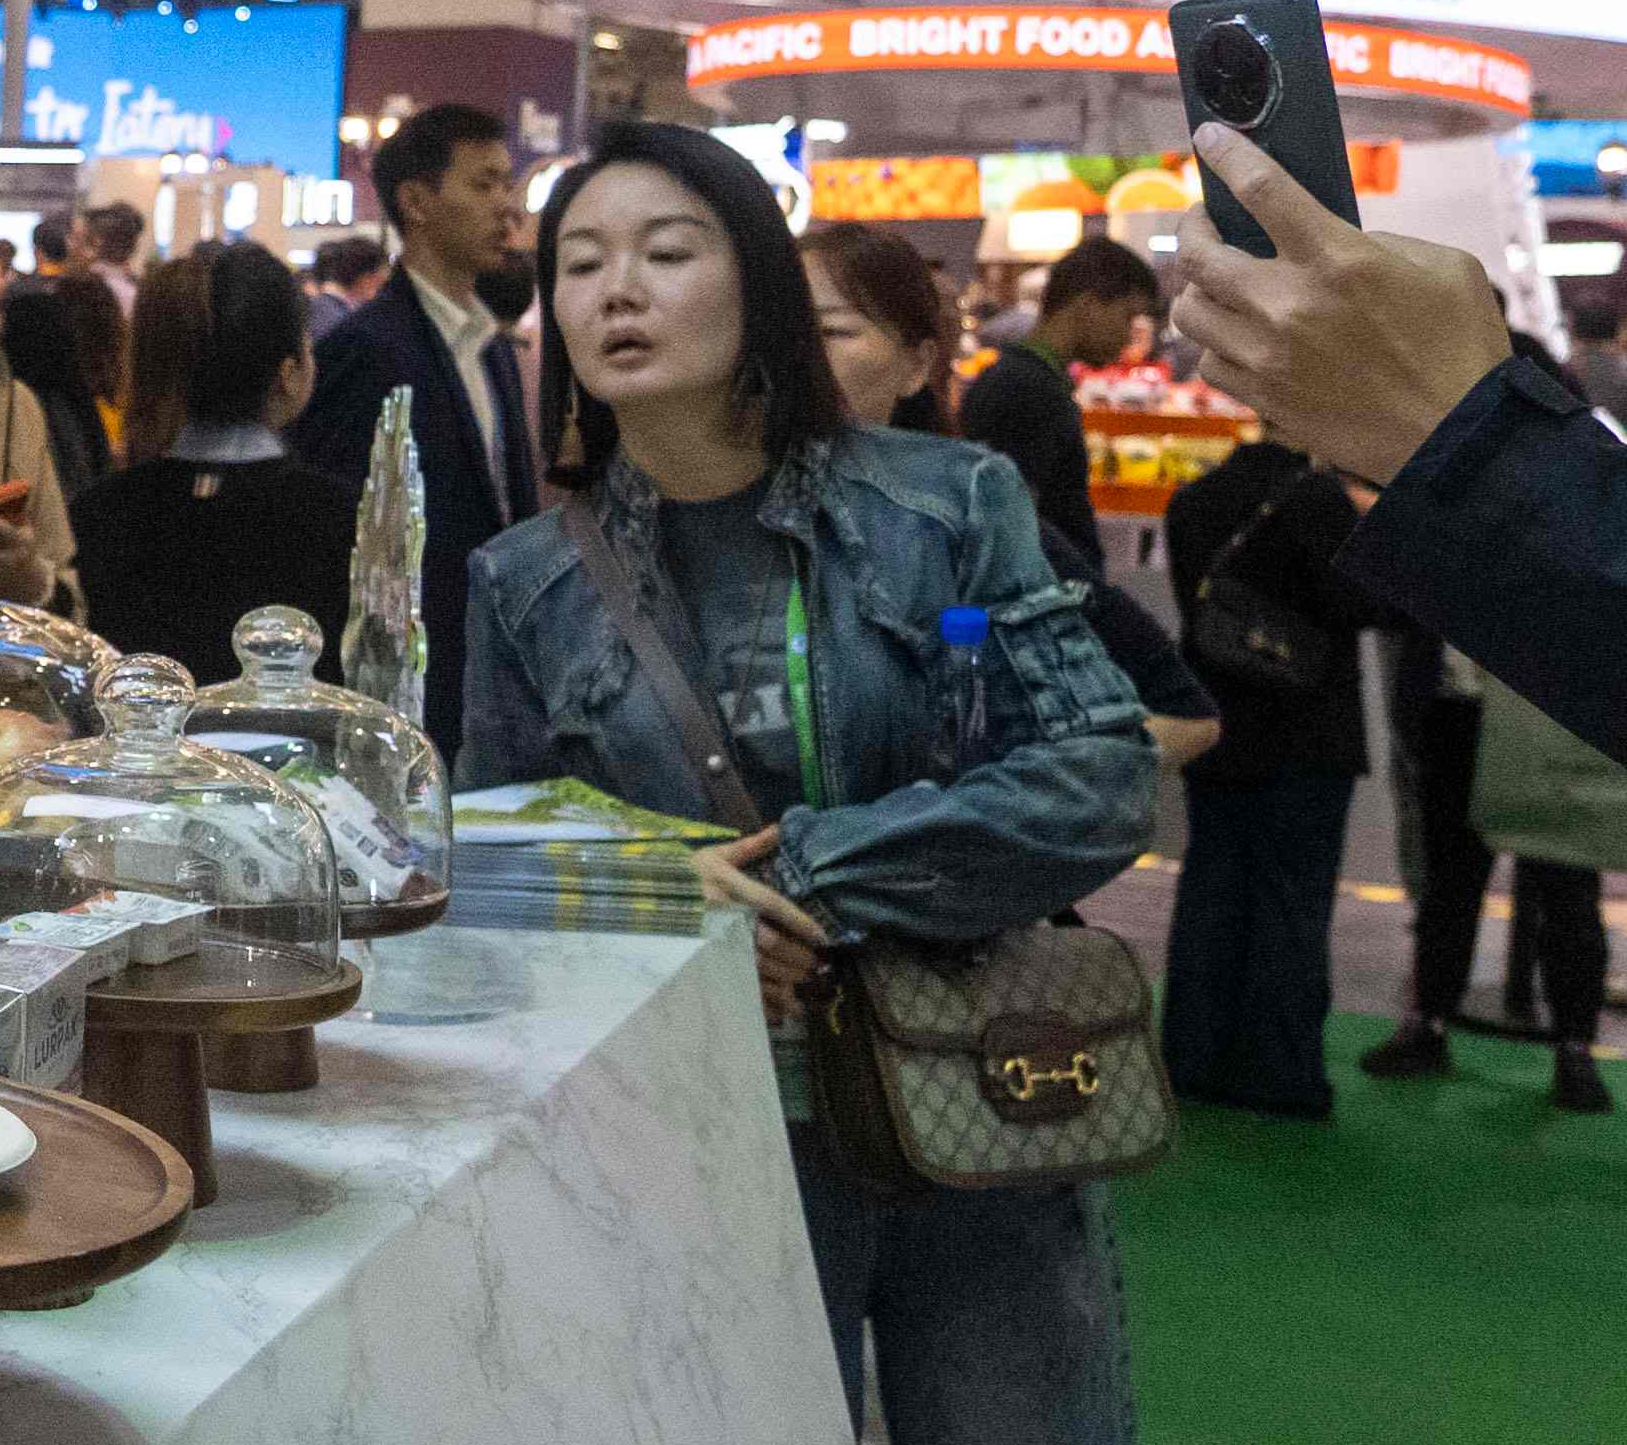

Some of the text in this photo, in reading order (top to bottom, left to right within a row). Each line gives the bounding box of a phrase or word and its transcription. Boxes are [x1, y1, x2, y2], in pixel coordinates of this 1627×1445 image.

[702, 20, 824, 71] PACIFIC
[849, 16, 1009, 58] BRIGHT
[1014, 15, 1133, 59] FOOD
